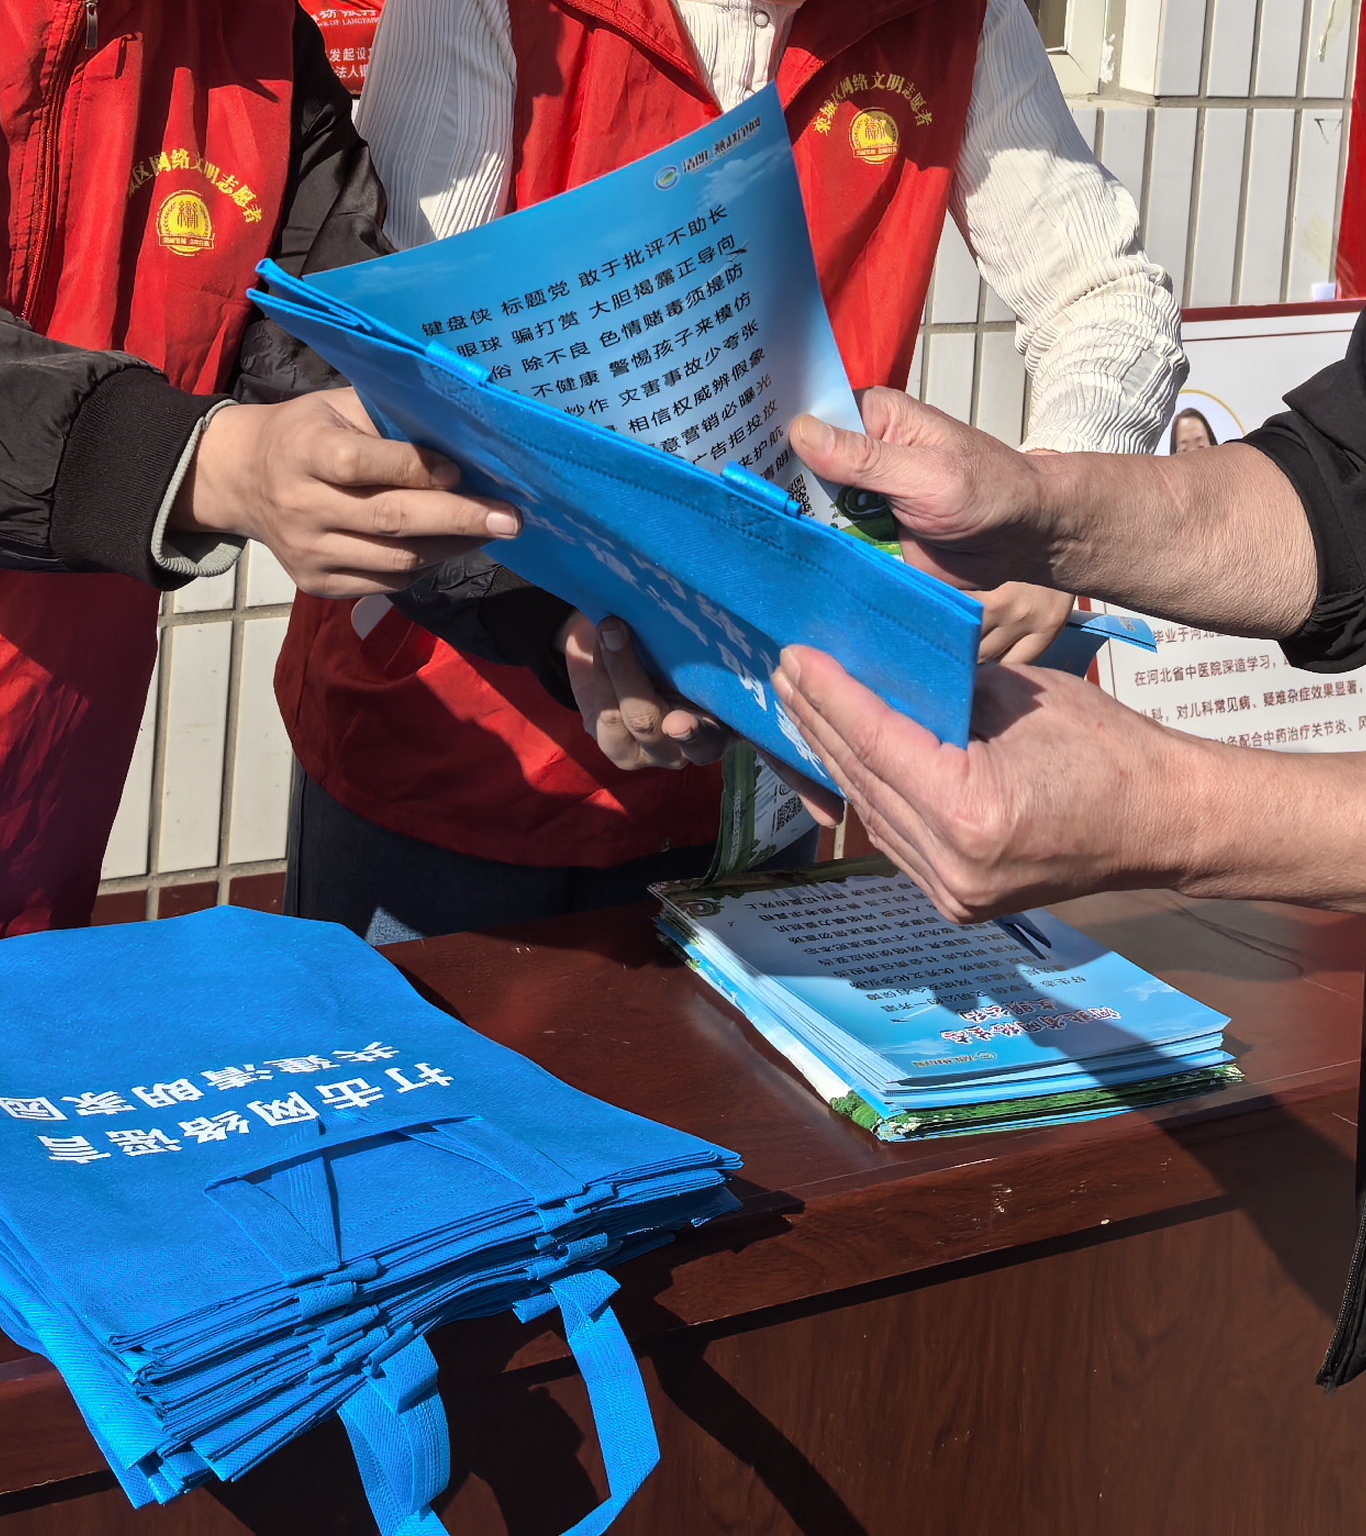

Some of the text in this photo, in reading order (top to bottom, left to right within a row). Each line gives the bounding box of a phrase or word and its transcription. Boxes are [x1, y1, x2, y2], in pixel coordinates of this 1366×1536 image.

[329, 47, 372, 62] 发起设
[421, 204, 728, 337] 键盘侠 标题党 敢于批评不助长
[511, 311, 580, 345] 骗打赏
[589, 234, 736, 319] 大胆揭露正导向
[521, 341, 591, 372] 除不良
[599, 261, 743, 348] 色情赌毒须提防
[532, 290, 752, 399] 不健康 警惕孩子来模仿
[617, 319, 758, 407] 灾害事故少夸张
[627, 348, 765, 433] 相信权威辨假象
[649, 373, 772, 453] 意营销必曝光
[1154, 626, 1225, 645] 毕业于河北
[37, 1064, 455, 1164] 打击网络谣言
